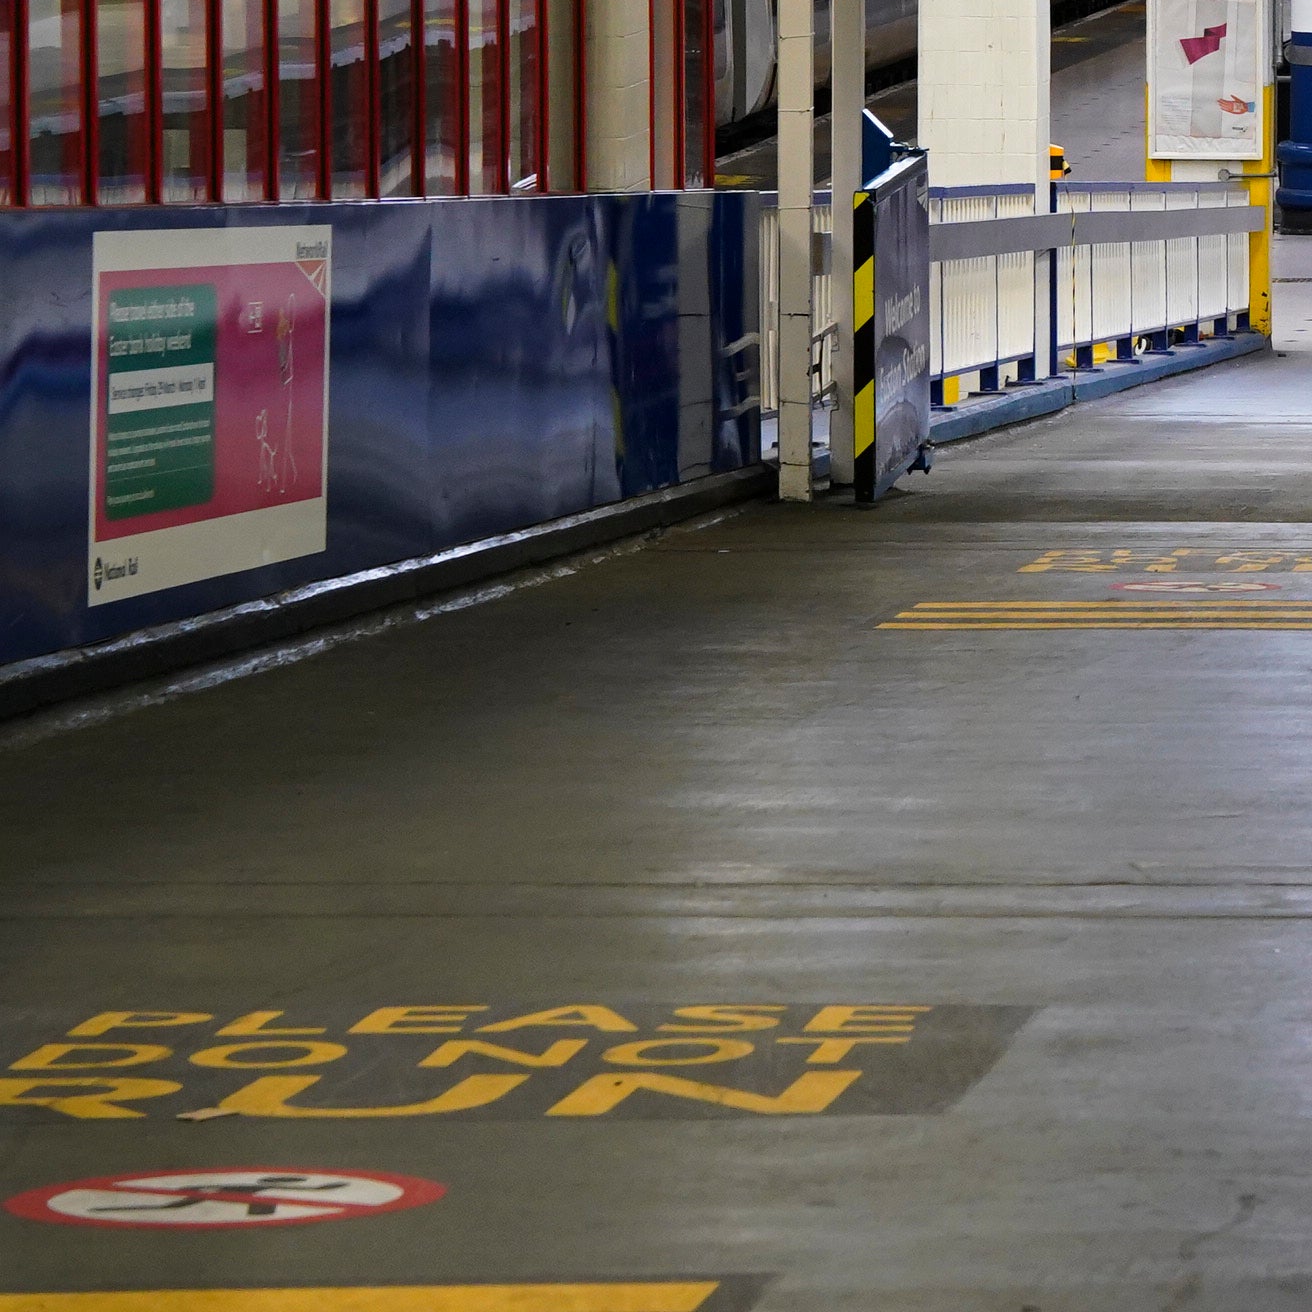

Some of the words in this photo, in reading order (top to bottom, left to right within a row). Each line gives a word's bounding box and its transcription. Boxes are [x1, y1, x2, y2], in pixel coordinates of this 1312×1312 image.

[67, 1004, 934, 1035] PLEASE
[8, 1041, 349, 1072] DO
[417, 1035, 912, 1069] NOT
[0, 1070, 863, 1120] RUN
